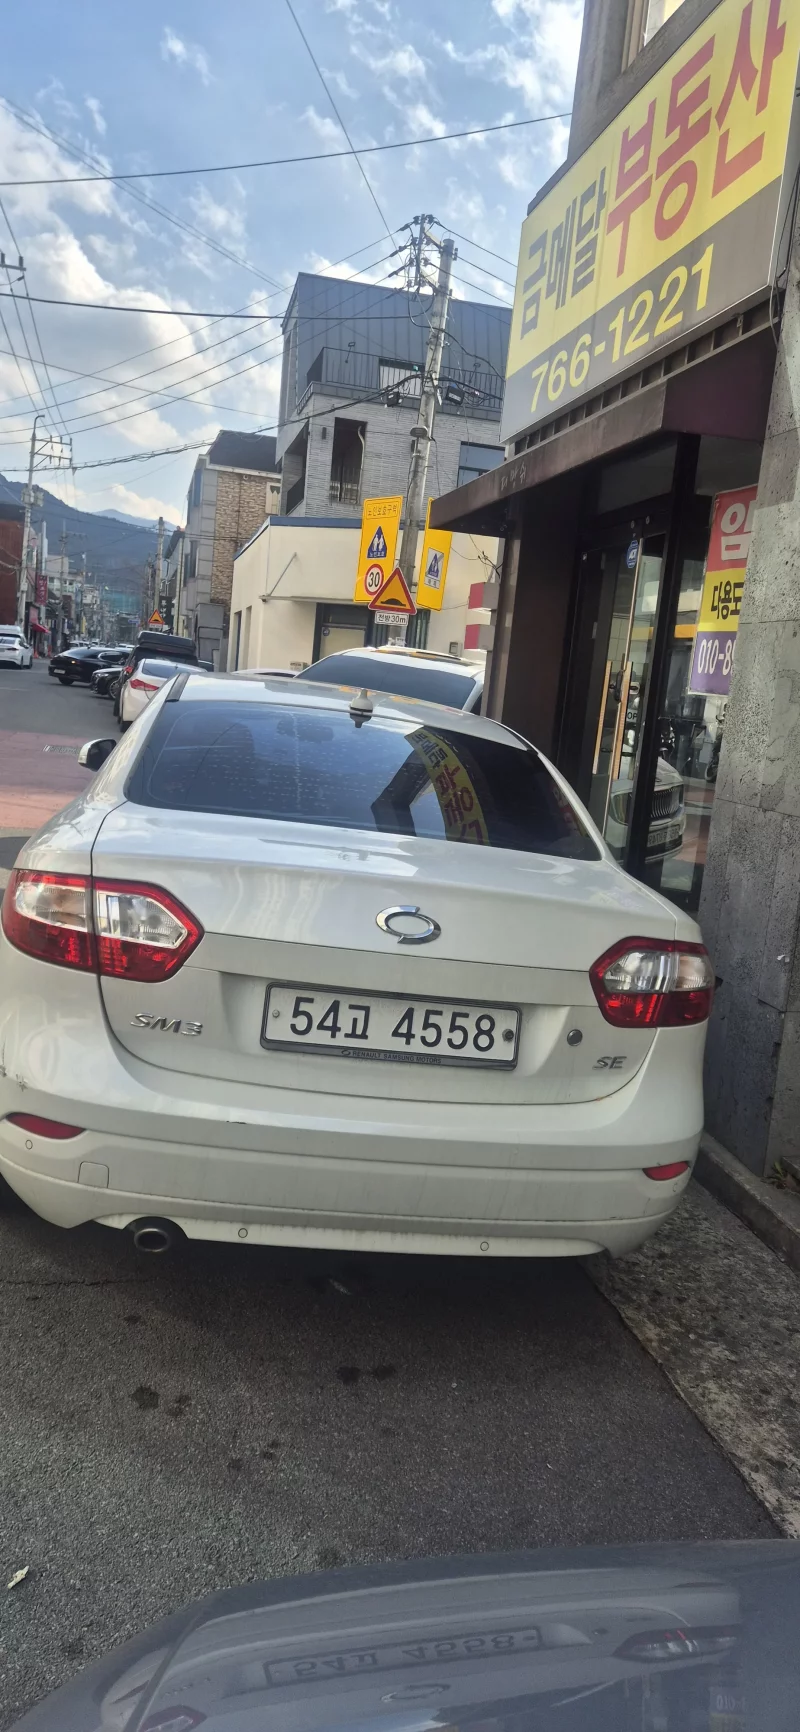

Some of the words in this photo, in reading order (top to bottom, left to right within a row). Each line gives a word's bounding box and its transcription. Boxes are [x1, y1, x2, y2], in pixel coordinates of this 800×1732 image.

[520, 167, 606, 341] 금메달
[606, 0, 787, 279] 부동산
[530, 243, 715, 413] 766-1221
[368, 572, 381, 587] 30
[697, 639, 736, 676] 010-8
[130, 1012, 204, 1037] SM3
[289, 996, 371, 1040] 54고
[391, 1006, 496, 1052] 4558
[352, 1050, 381, 1059] RENAULT
[383, 1053, 415, 1062] SAMSUNG
[416, 1056, 442, 1064] MOTORS
[592, 1055, 628, 1070] SE
